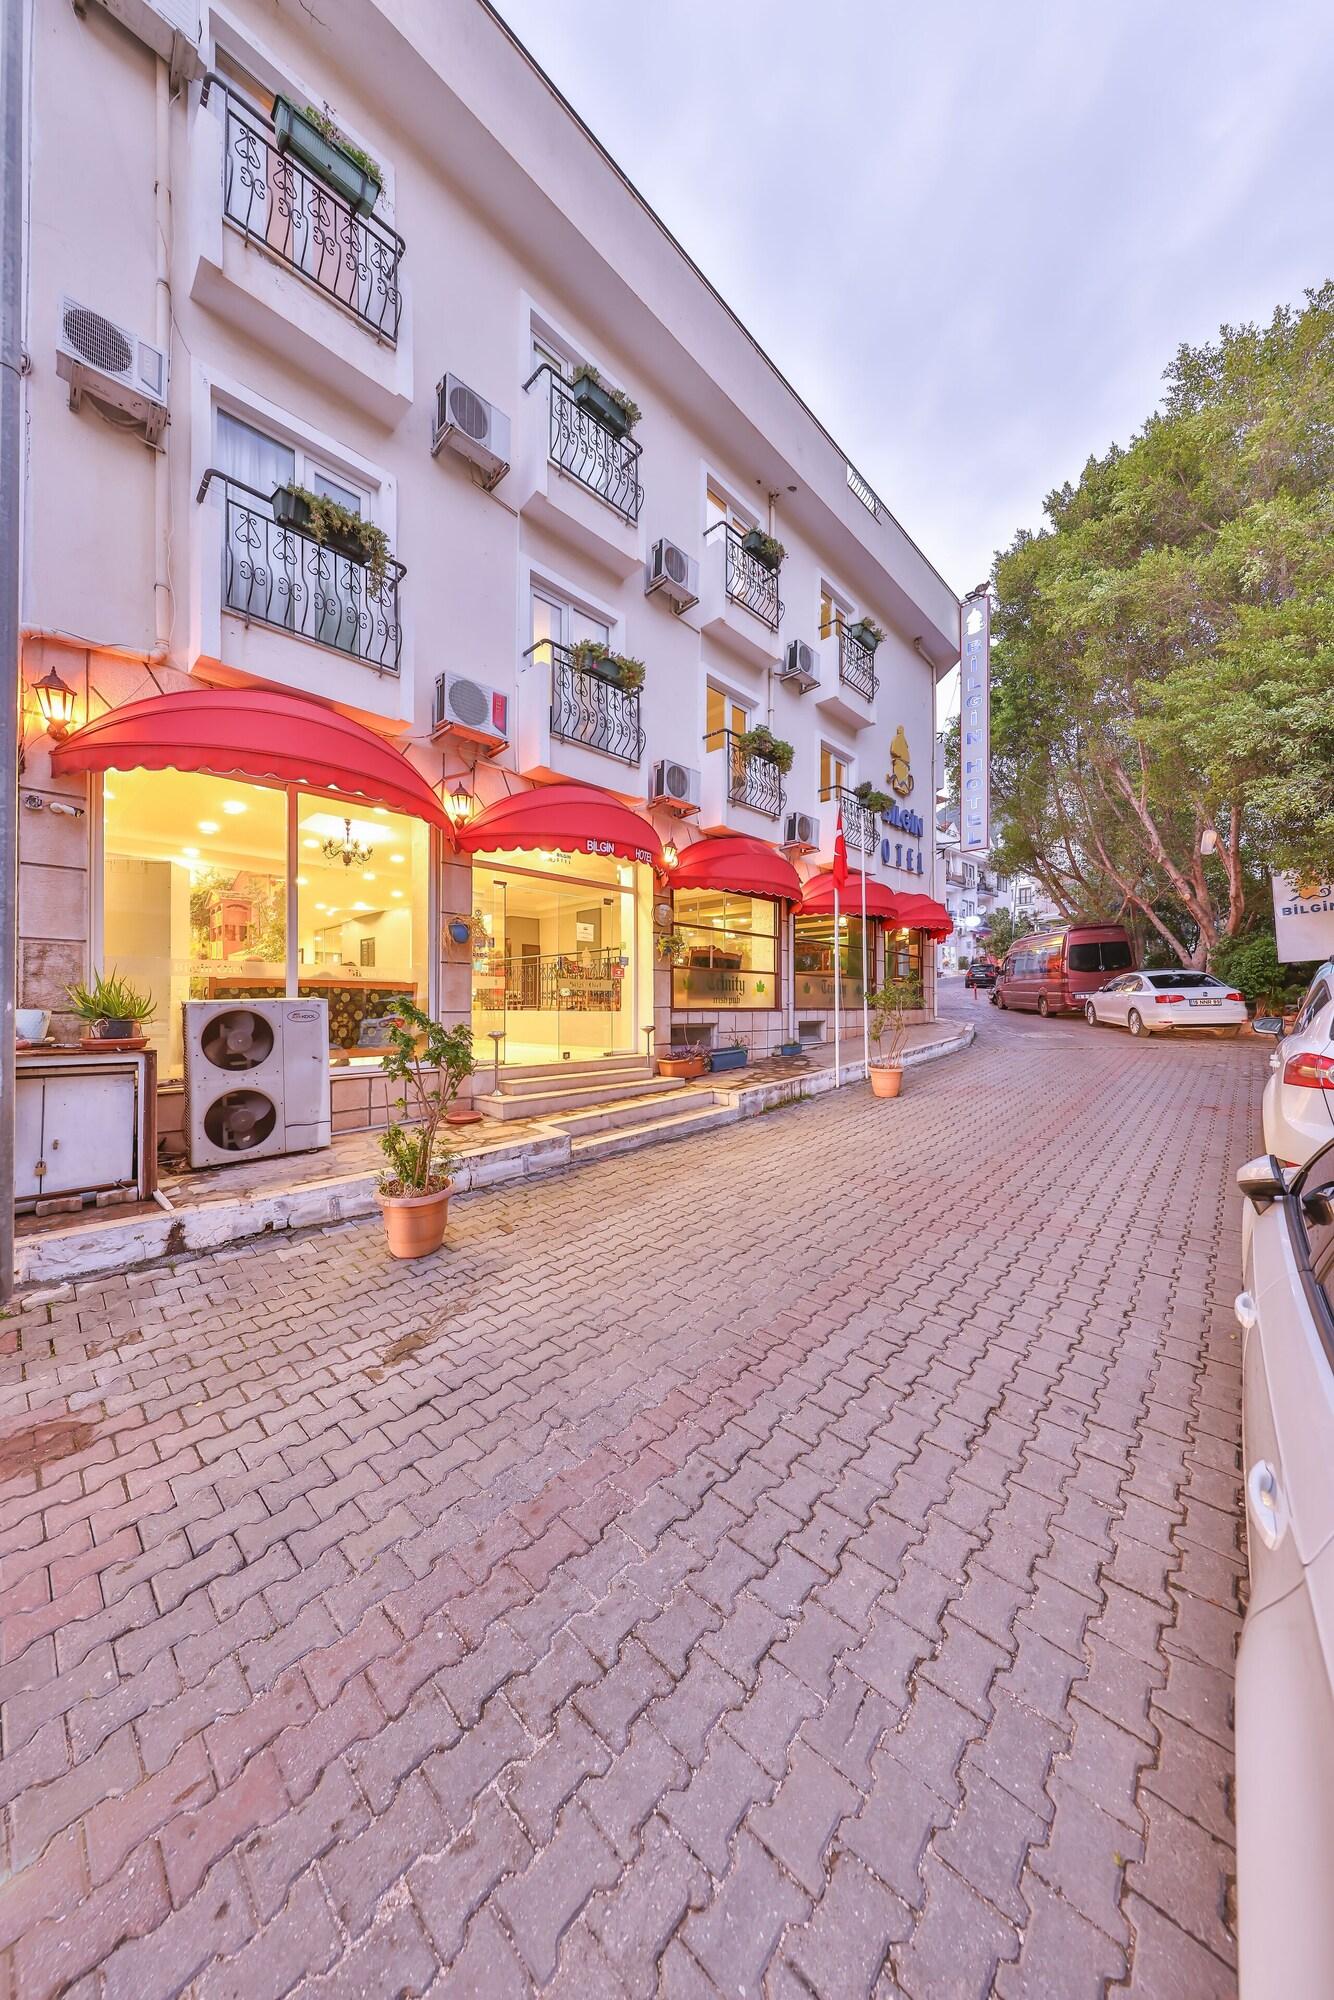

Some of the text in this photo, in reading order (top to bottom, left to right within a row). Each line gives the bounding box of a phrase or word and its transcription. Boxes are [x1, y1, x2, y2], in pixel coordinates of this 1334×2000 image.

[966, 759, 983, 845] HOTEL
[587, 839, 615, 853] BİLGİN
[881, 839, 923, 875] OTEL
